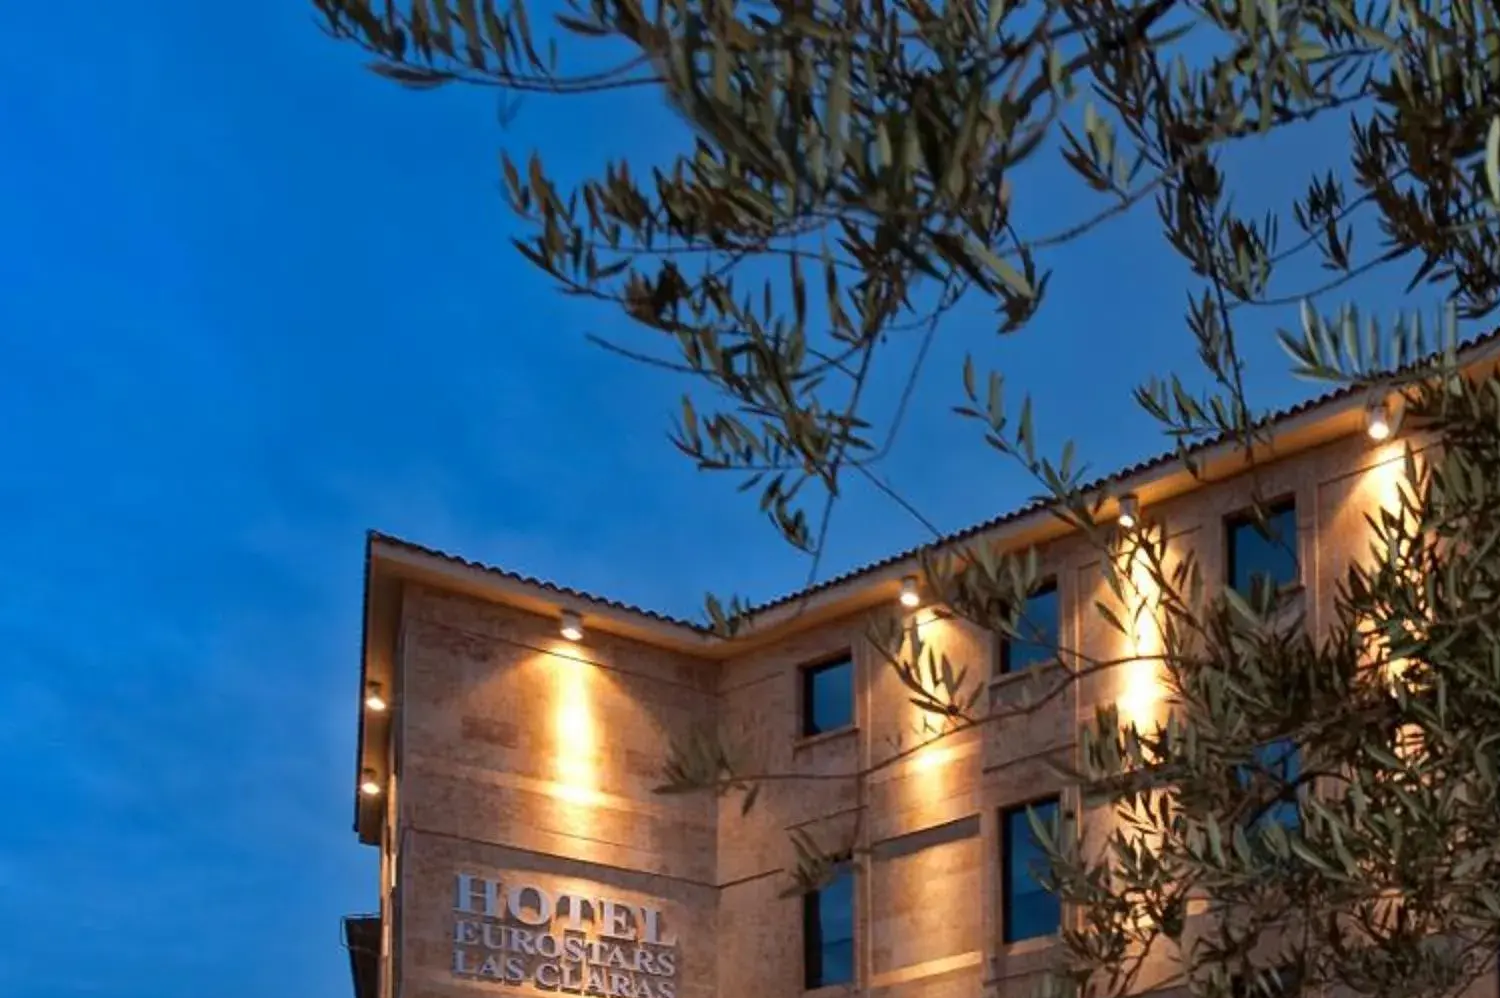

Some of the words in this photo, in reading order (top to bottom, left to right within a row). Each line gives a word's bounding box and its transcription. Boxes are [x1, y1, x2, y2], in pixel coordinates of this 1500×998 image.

[452, 873, 678, 946] HOTEL
[454, 920, 676, 976] EUROSTARS
[454, 951, 525, 981] LAS
